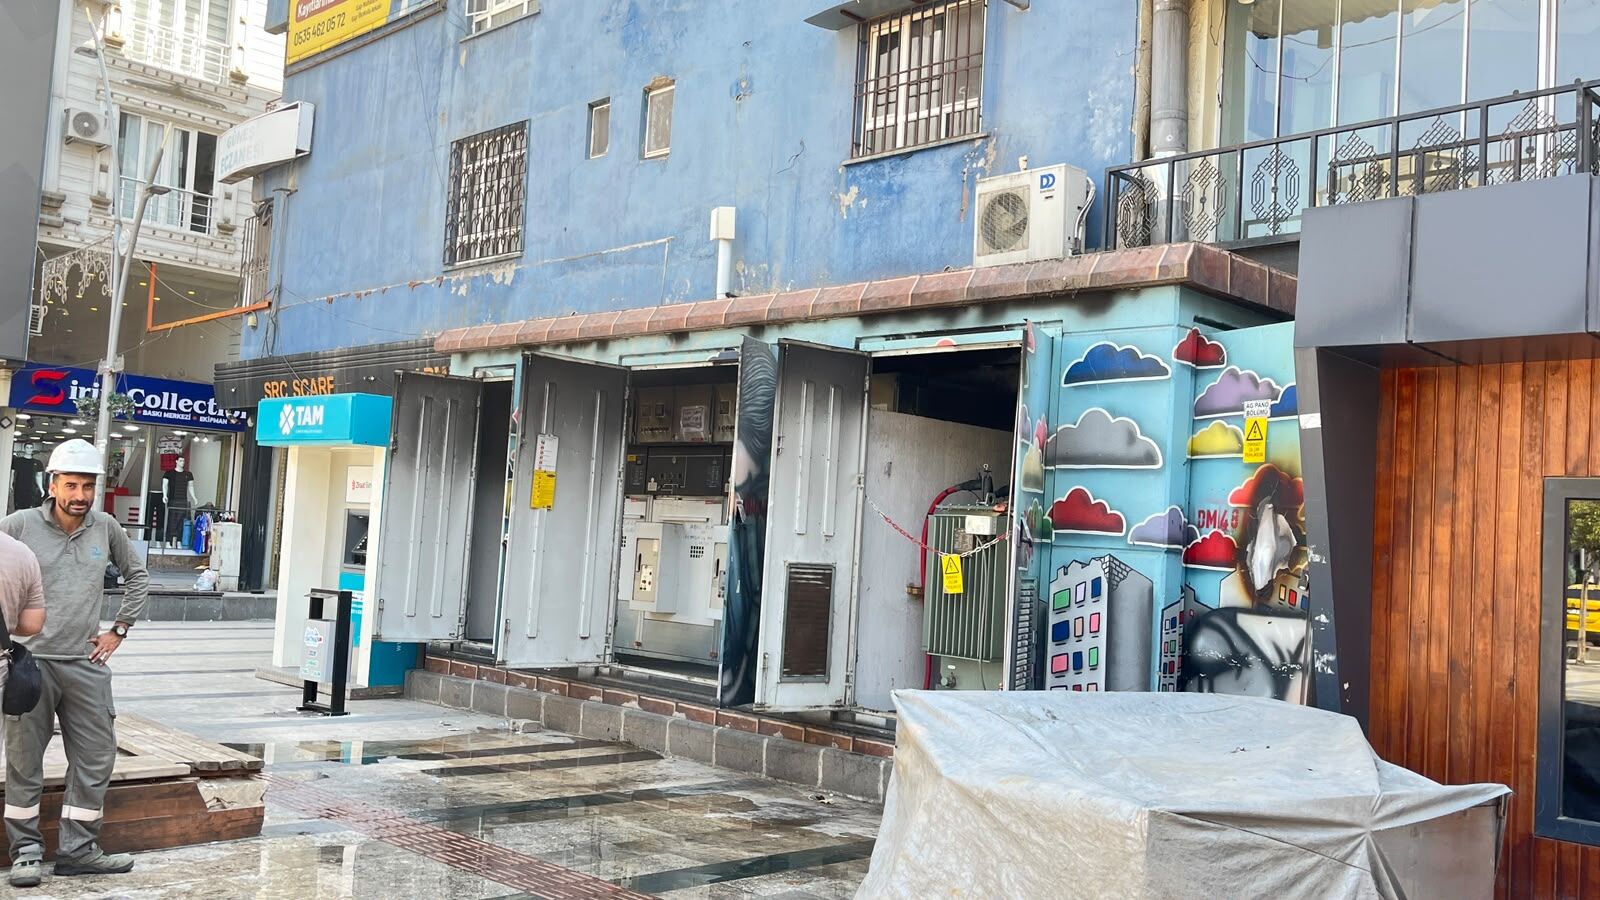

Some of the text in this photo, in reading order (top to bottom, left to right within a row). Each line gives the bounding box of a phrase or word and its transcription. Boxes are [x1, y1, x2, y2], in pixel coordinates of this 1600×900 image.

[293, 30, 311, 47] 0535
[311, 20, 325, 37] 462
[326, 16, 336, 33] 05
[336, 12, 346, 28] 72
[264, 380, 289, 398] SRC
[127, 388, 247, 419] Collect
[295, 405, 324, 426] TAM
